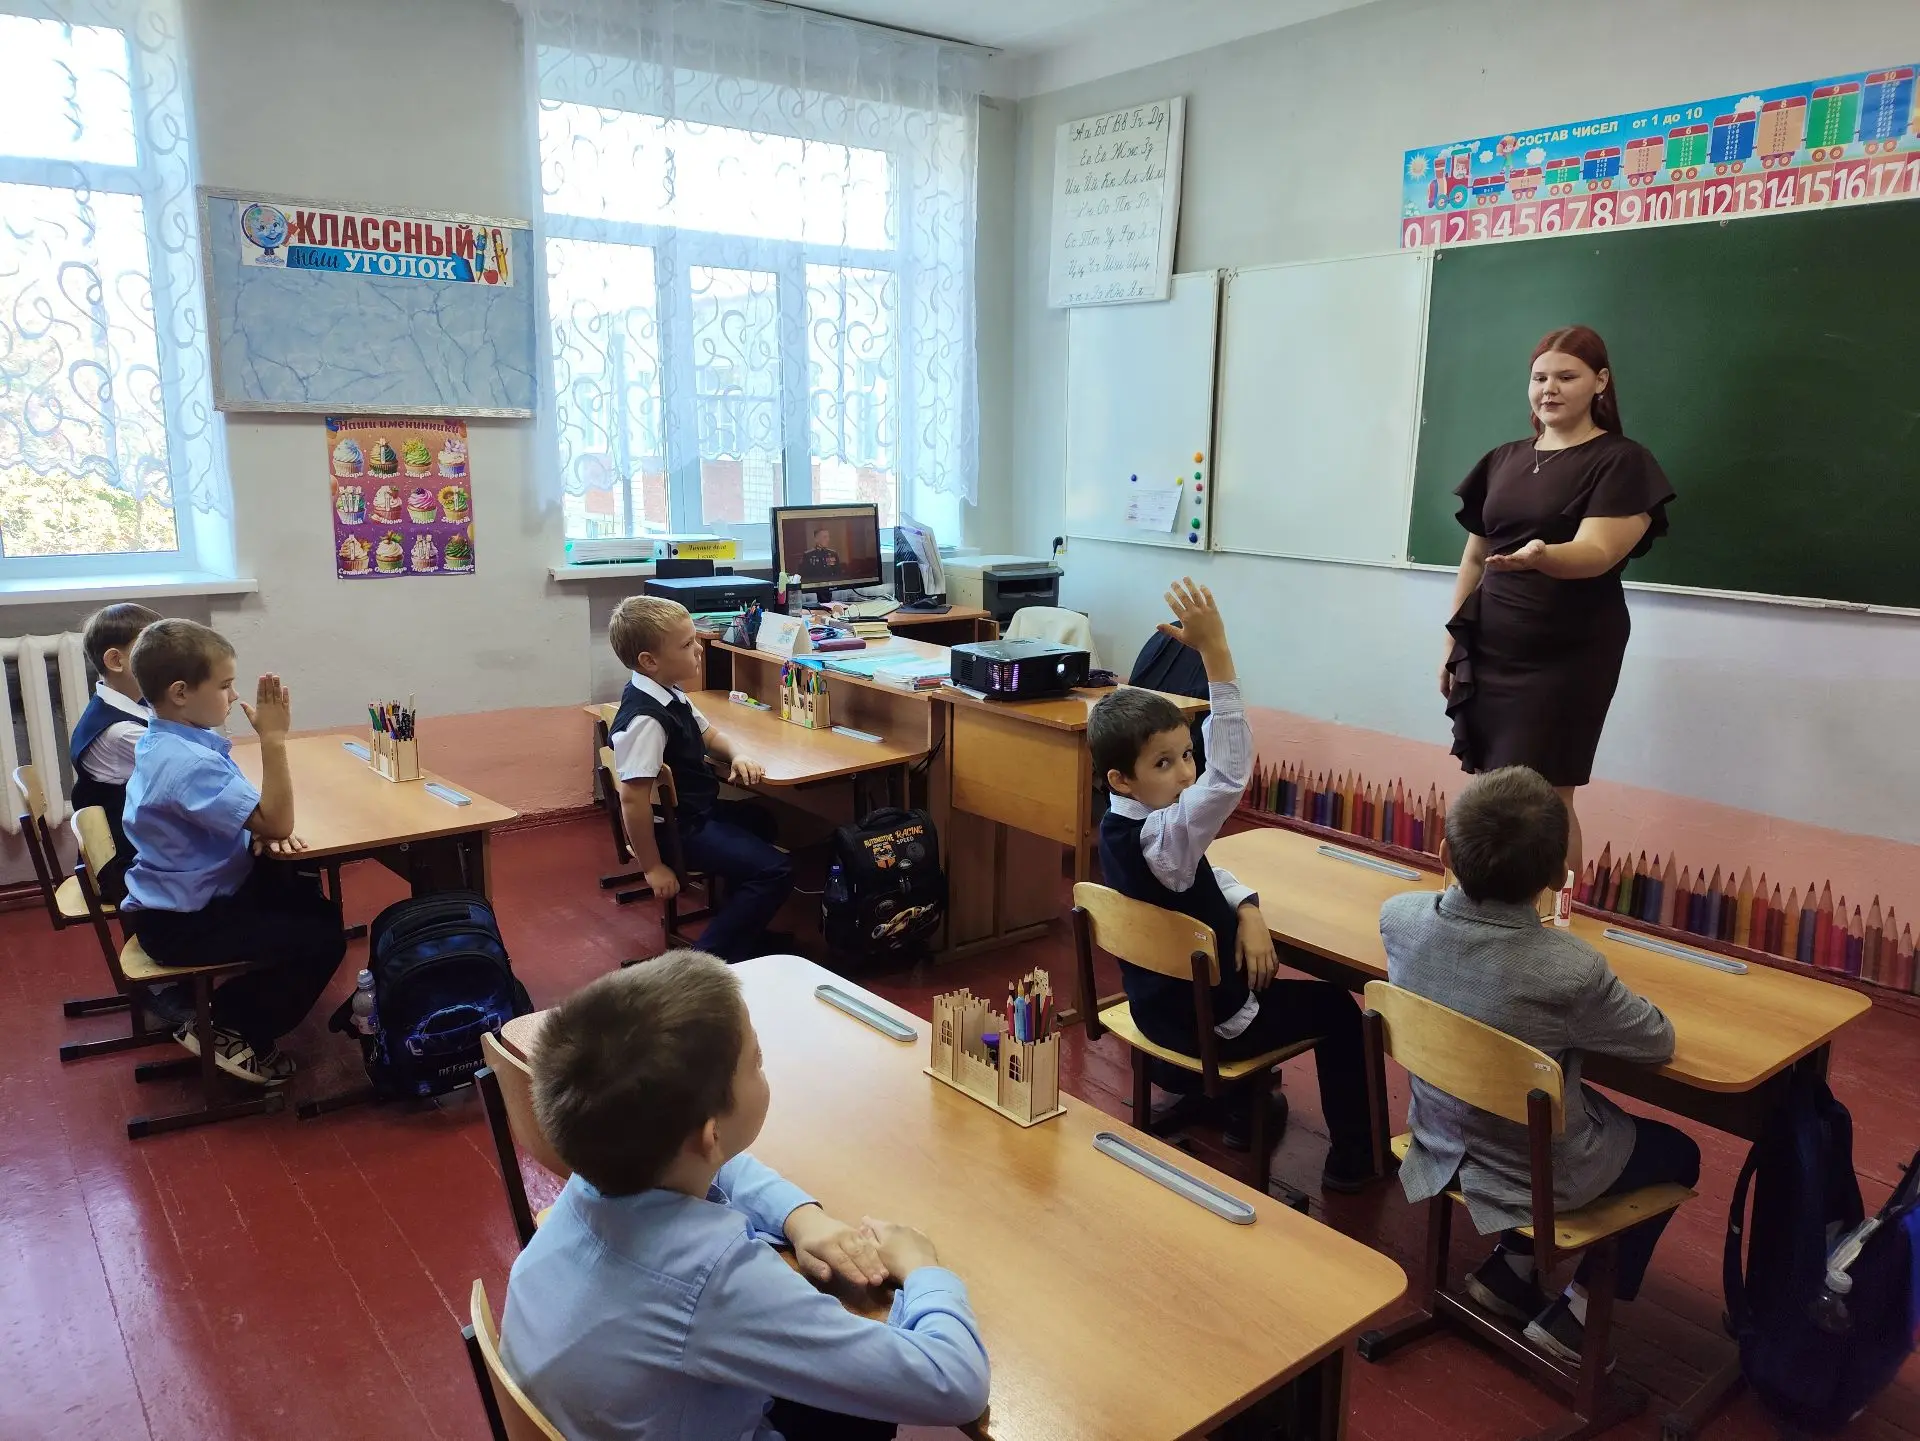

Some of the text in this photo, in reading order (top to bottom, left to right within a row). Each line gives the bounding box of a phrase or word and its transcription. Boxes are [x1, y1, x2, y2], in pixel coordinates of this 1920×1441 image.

[1885, 71, 1896, 81] 10
[1834, 86, 1840, 94] 9
[1781, 100, 1787, 108] 8
[1732, 113, 1738, 122] 7
[1517, 107, 1703, 147] СОСТАВ ЧИСЕЛ от 1 до 10
[1686, 126, 1692, 134] 6
[1405, 159, 1920, 249] 0 1 2 3 4 5 6 7 8 9 10 11 12 13 14 15 16 17 1
[296, 210, 474, 260] КЛАССНЫЙ
[344, 251, 456, 280] УГОЛОК
[339, 420, 459, 434] Наши именинники
[895, 825, 923, 838] RACING
